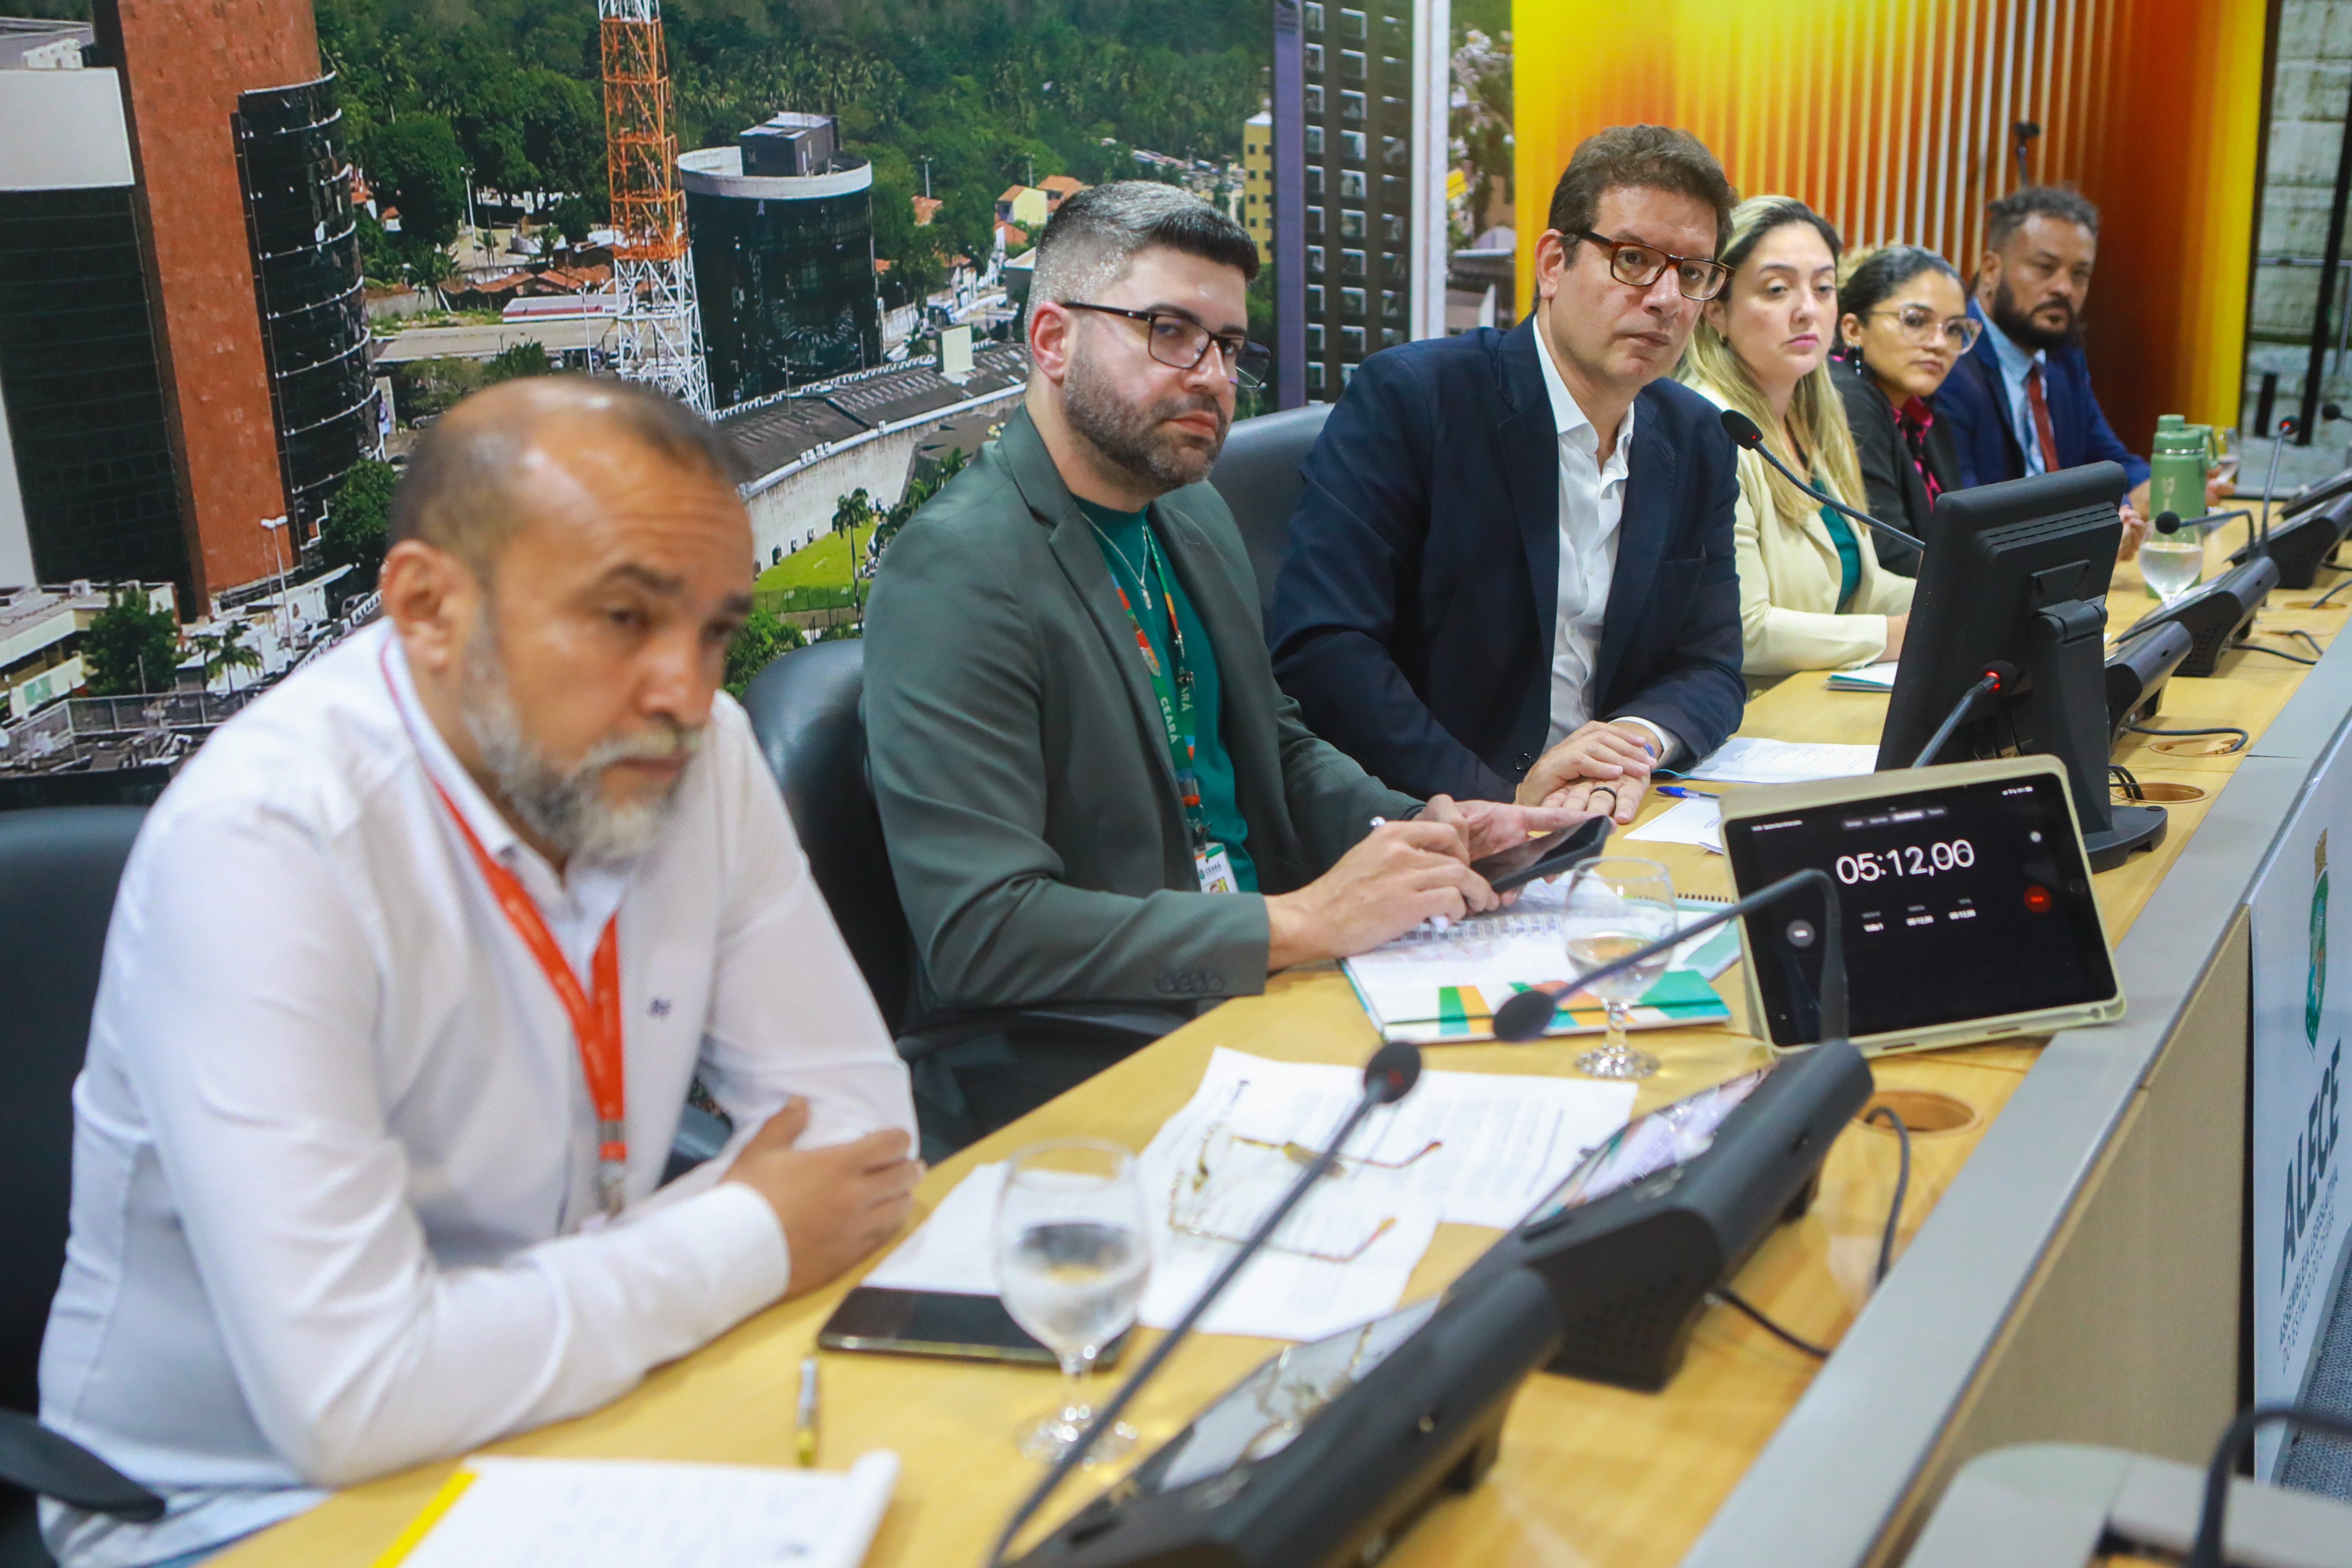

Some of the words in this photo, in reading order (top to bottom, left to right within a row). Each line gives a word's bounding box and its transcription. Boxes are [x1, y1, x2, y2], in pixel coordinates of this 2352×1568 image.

[1178, 666, 1193, 712] CARÁ
[1160, 696, 1182, 744] CEARÁ
[1836, 839, 1975, 885] 05:12,00
[2281, 1037, 2341, 1298] ALECE
